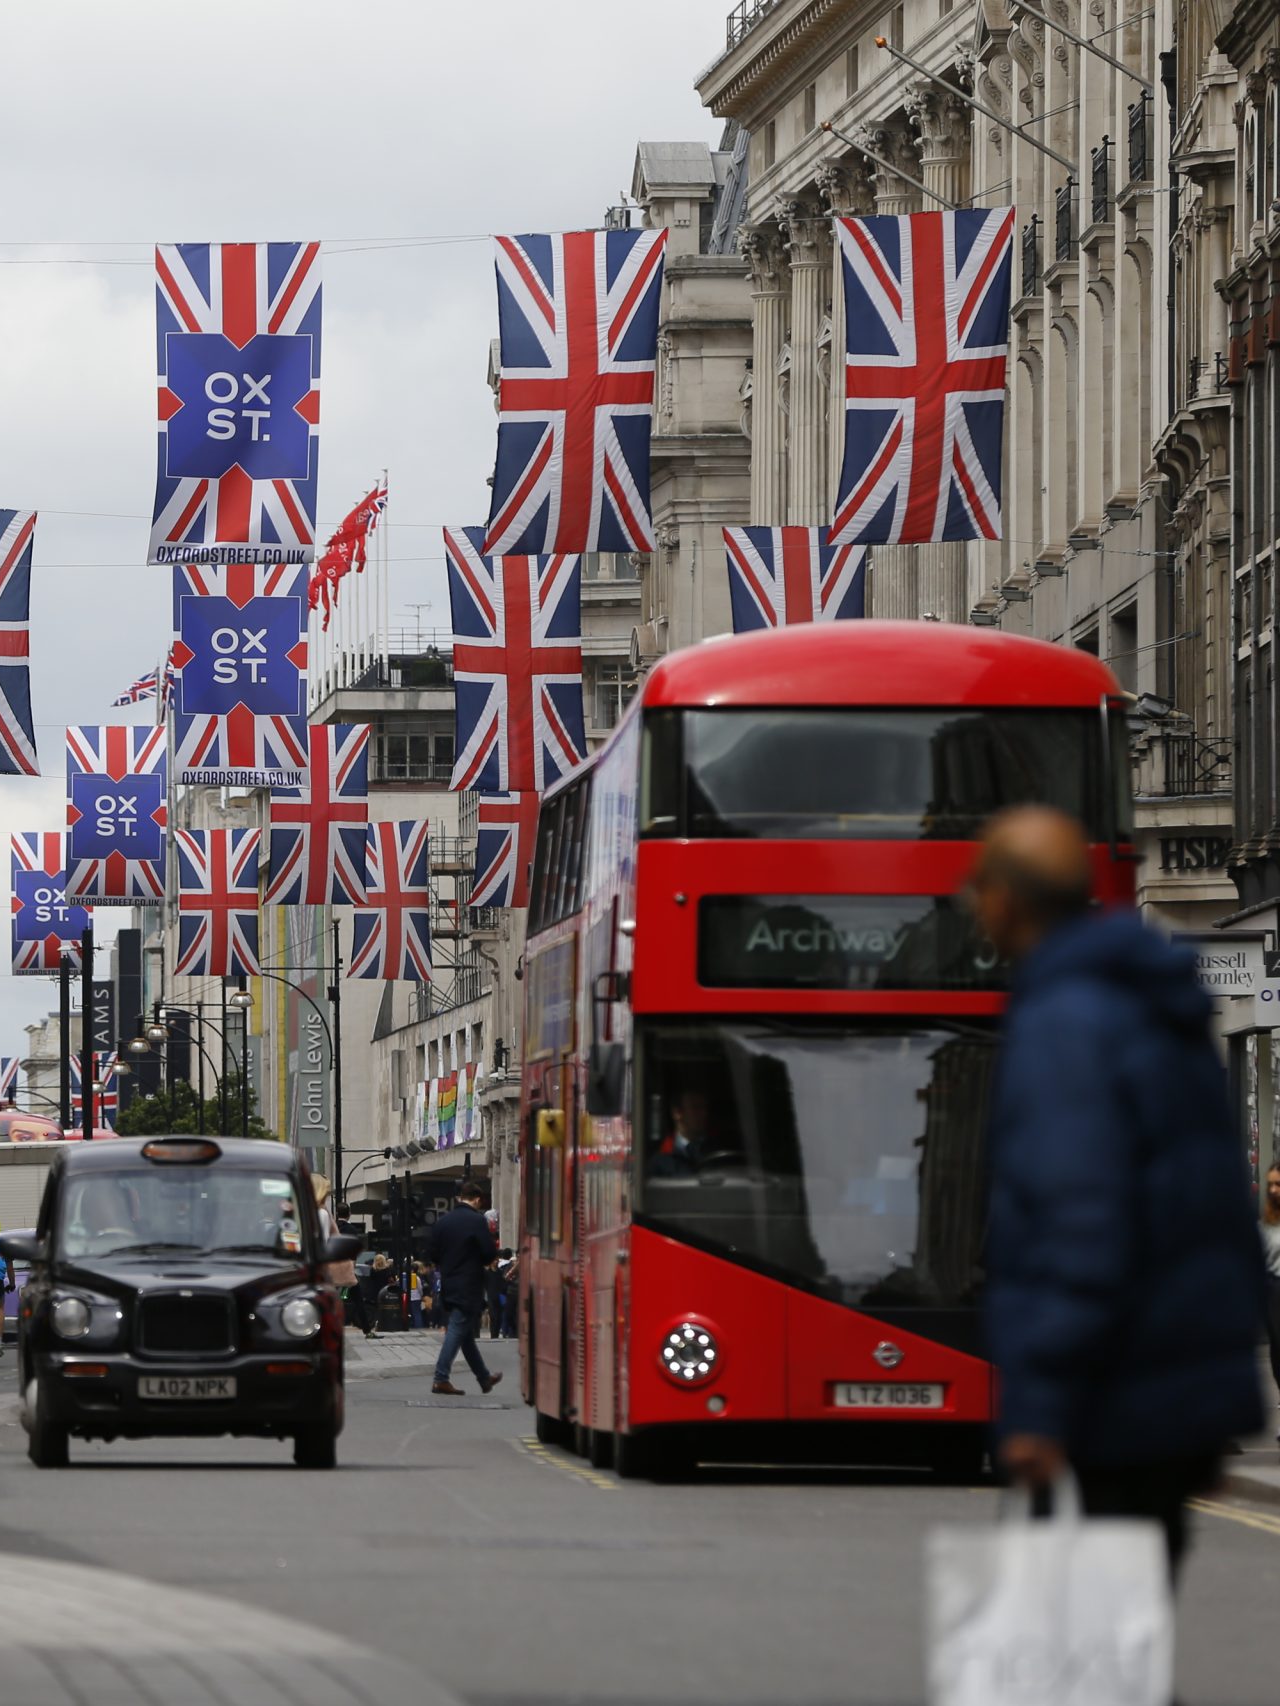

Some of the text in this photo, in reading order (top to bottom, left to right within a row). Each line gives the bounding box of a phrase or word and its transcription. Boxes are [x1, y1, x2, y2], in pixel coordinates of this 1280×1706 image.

[205, 371, 272, 405] OX
[205, 407, 271, 442] ST.
[156, 545, 306, 564] OXFORDSTREET.CO.UK
[211, 627, 268, 654] OX
[212, 657, 267, 684] ST.
[182, 770, 302, 786] OXFORDSTREET.CO.UK
[94, 795, 138, 815] OX
[95, 816, 138, 837] ST.
[1158, 837, 1232, 869] HSB
[33, 888, 66, 904] OX
[70, 896, 160, 906] OXFORDSTREET.CO.UK
[35, 906, 69, 922] ST.
[746, 919, 909, 961] Archway
[1195, 969, 1256, 988] romley
[94, 988, 110, 1045] AMS
[301, 1014, 329, 1132] John Lewis
[145, 1379, 229, 1396] LA02 NPK
[846, 1386, 932, 1405] LTZ 1036
